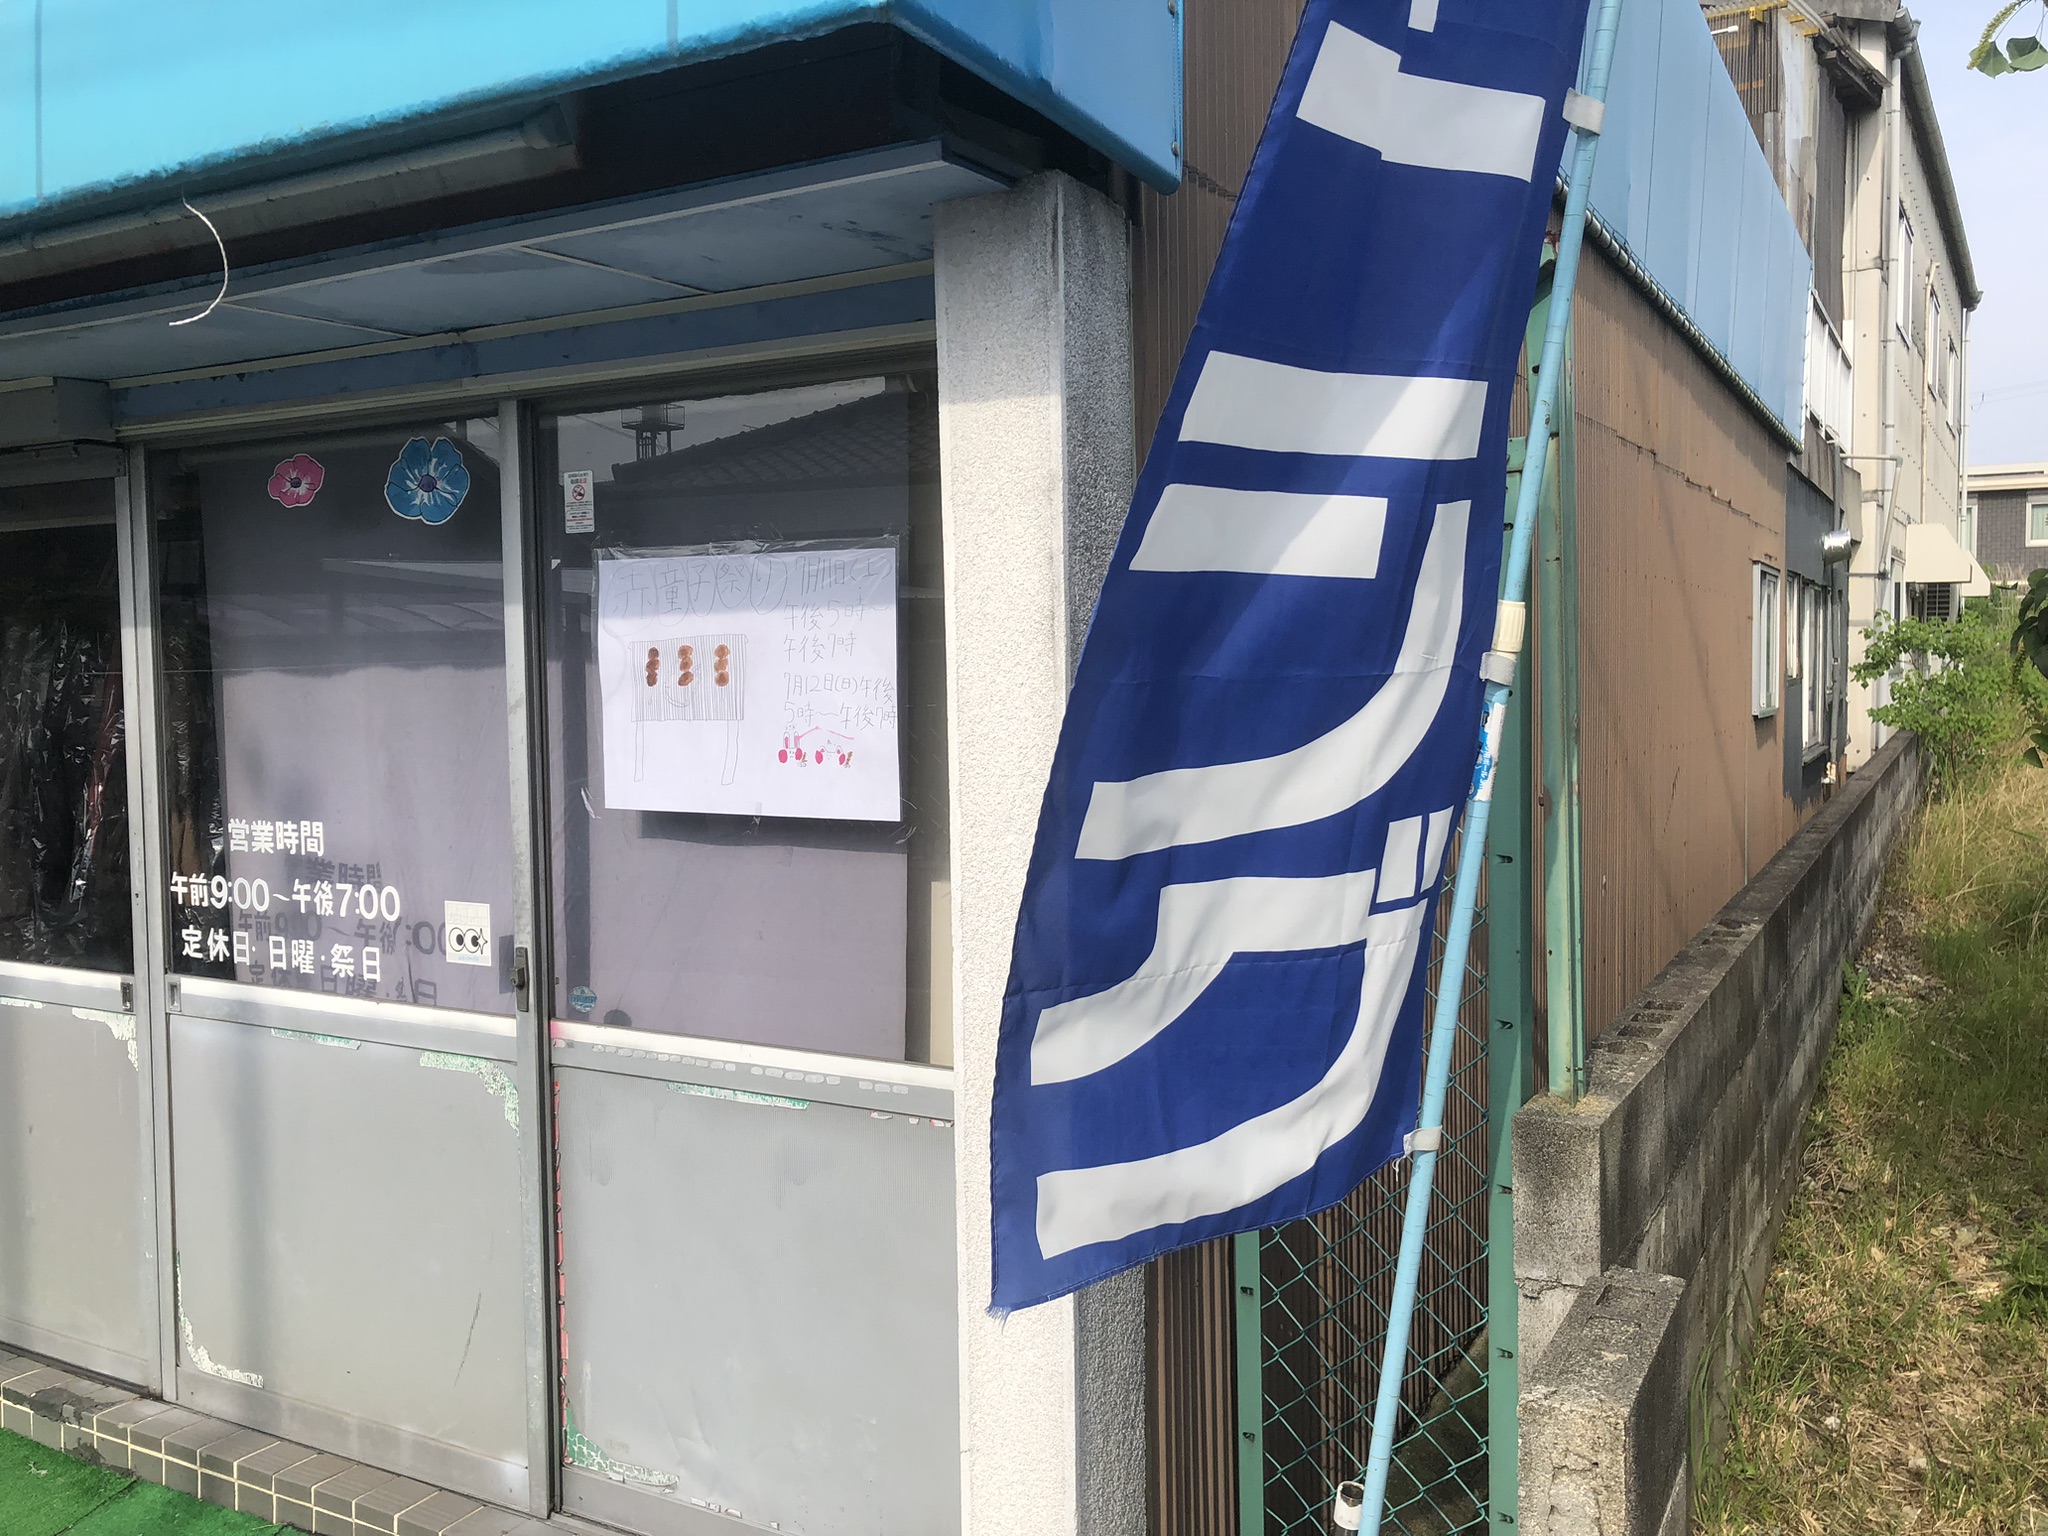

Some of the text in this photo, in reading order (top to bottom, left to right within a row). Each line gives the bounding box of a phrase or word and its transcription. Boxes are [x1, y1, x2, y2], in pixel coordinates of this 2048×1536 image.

[783, 630, 857, 664] 午後7時
[1031, 0, 1546, 1260] ニング
[227, 818, 324, 857] 営業時間
